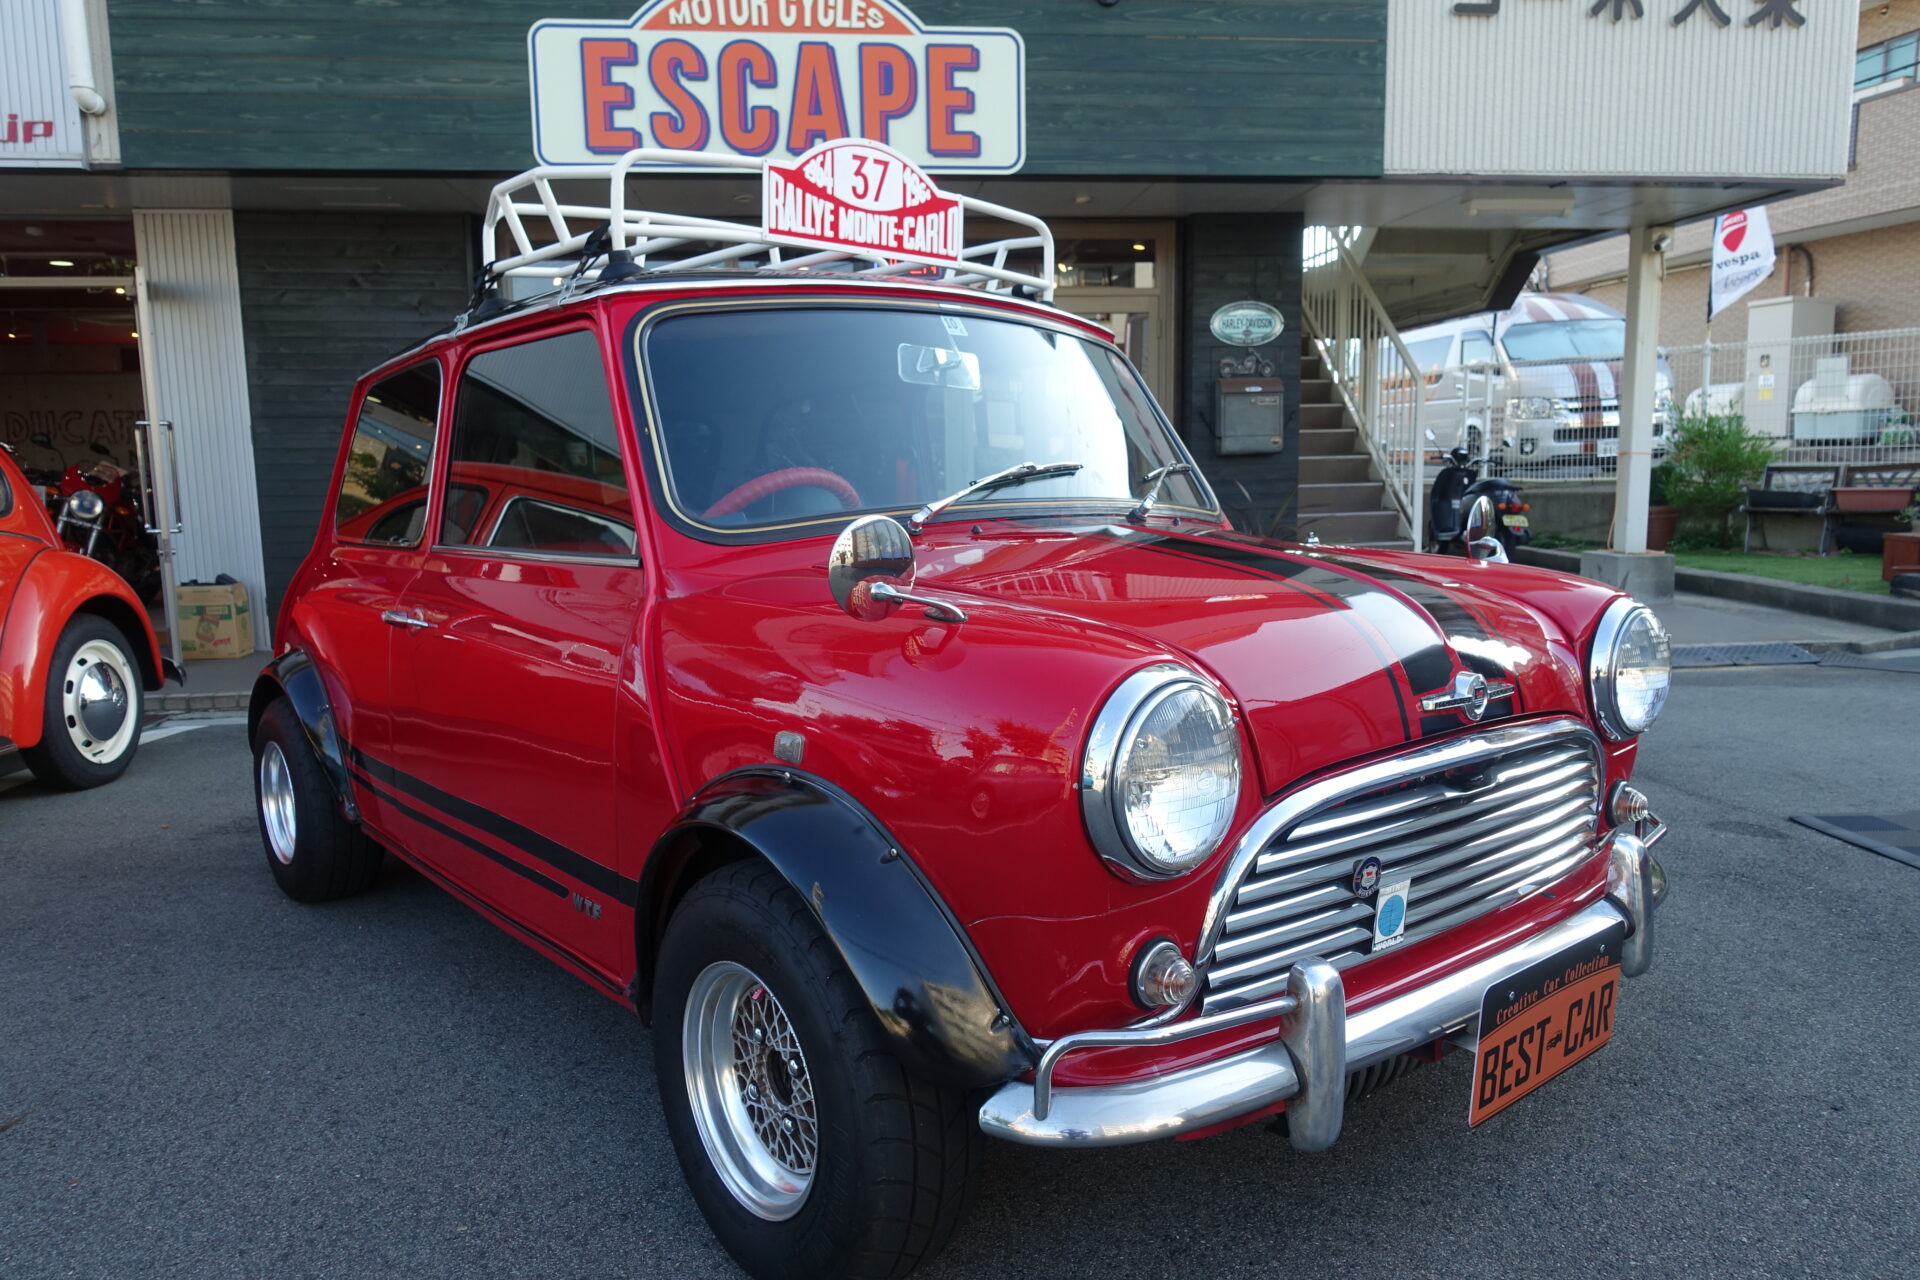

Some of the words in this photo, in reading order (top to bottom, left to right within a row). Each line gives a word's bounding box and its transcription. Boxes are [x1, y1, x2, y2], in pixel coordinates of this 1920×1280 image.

[779, 0, 885, 28] CYCLES
[580, 38, 980, 157] ESCAPE
[769, 170, 834, 238] RALLYE
[851, 154, 890, 202] 37
[1716, 251, 1761, 270] vespa
[6, 410, 145, 446] DUCAT
[1496, 990, 1538, 1025] Creative
[1543, 976, 1560, 994] Car
[1565, 955, 1609, 984] Collection
[1478, 1016, 1552, 1110] BEST
[1563, 980, 1614, 1057] CAR
